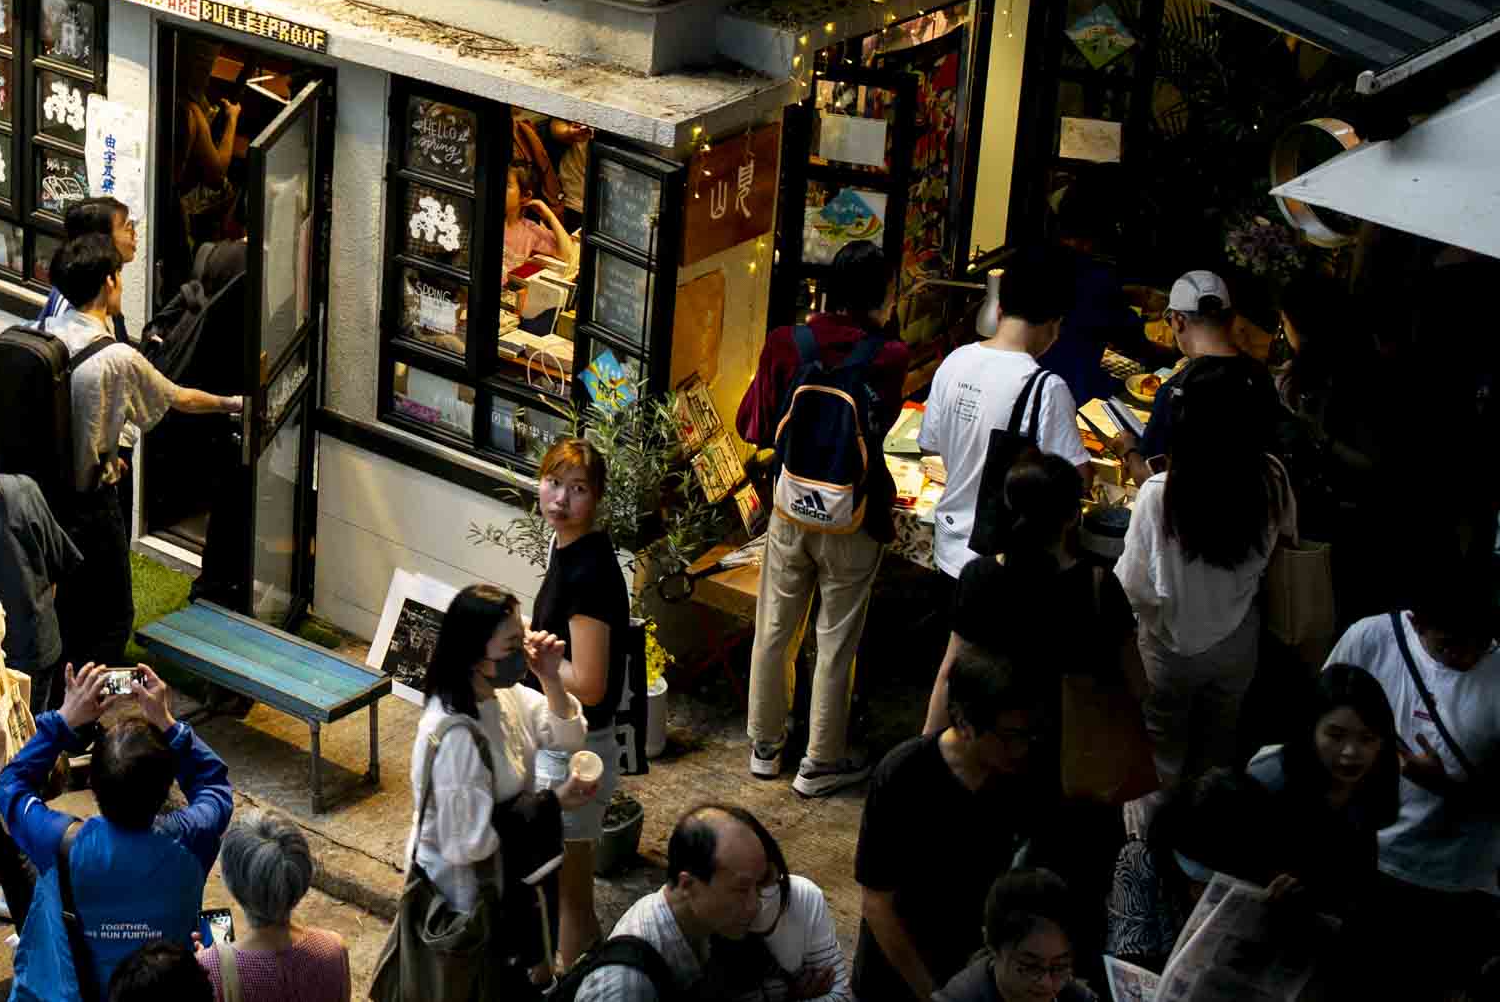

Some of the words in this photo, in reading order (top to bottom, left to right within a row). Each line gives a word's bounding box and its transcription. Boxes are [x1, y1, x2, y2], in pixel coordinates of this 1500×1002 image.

[202, 0, 326, 50] BULLETPROOF
[422, 117, 458, 142] HELLO
[791, 502, 833, 522] adidas
[100, 931, 121, 939] RUN
[122, 931, 163, 939] FURTHER
